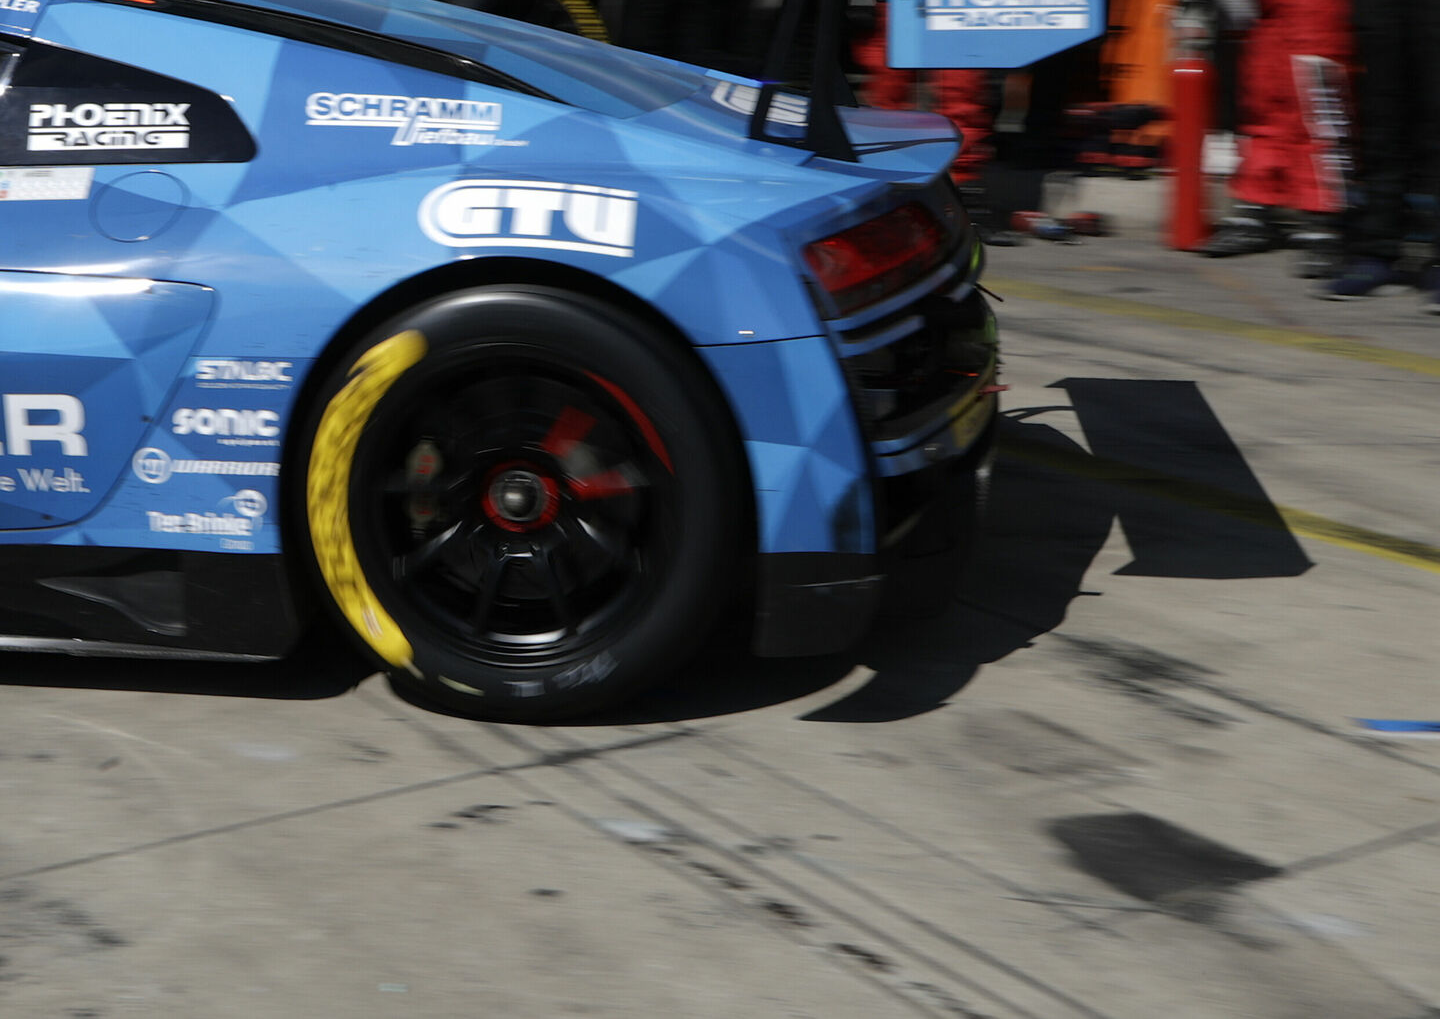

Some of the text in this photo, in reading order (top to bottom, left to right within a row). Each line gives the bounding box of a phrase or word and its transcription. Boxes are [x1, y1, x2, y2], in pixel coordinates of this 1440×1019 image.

[28, 103, 191, 127] PHOENIX
[307, 93, 502, 124] SCHRAMM
[16, 467, 91, 494] Welt.
